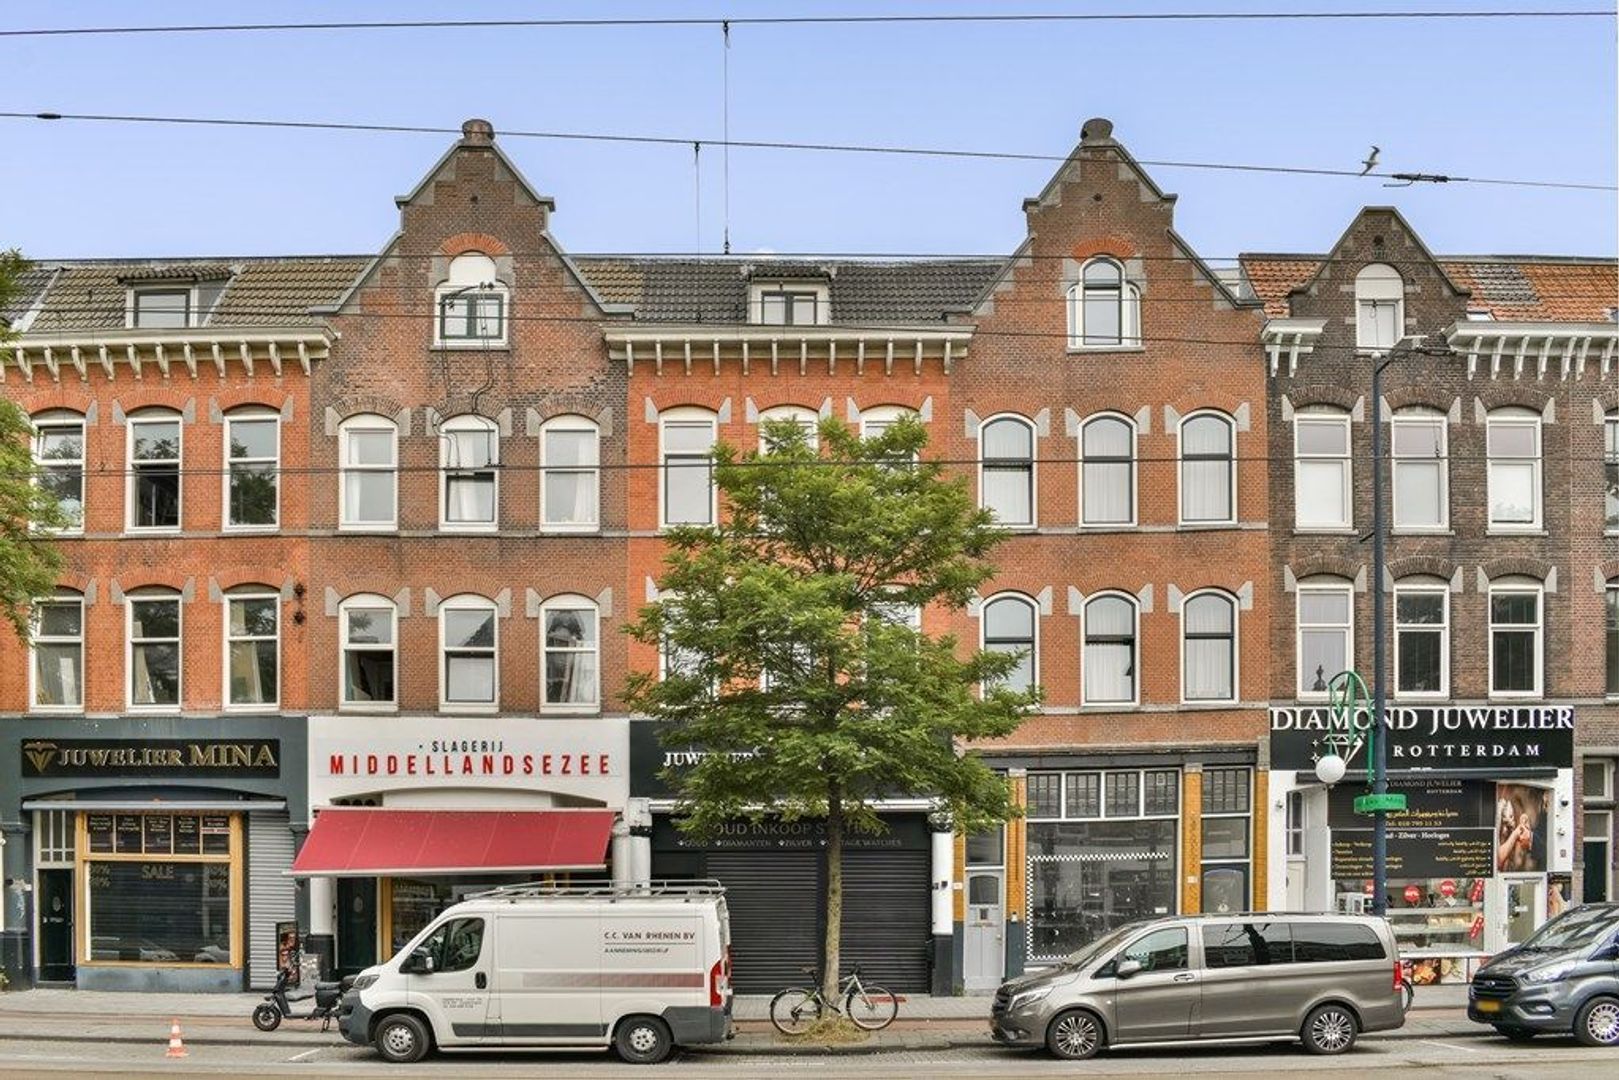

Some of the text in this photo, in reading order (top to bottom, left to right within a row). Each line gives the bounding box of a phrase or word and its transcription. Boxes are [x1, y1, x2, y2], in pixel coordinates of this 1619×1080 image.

[1271, 708, 1574, 735] DIAMOND JUWELIER
[431, 741, 503, 752] SLAGERIJ
[1393, 745, 1540, 757] ROTTERDAM
[57, 744, 278, 767] JUWELIER MINA
[329, 755, 609, 775] MIDDELLANDSEZEE
[752, 823, 813, 835] INKOOP
[141, 864, 174, 877] SALE
[645, 932, 681, 940] RHENEN
